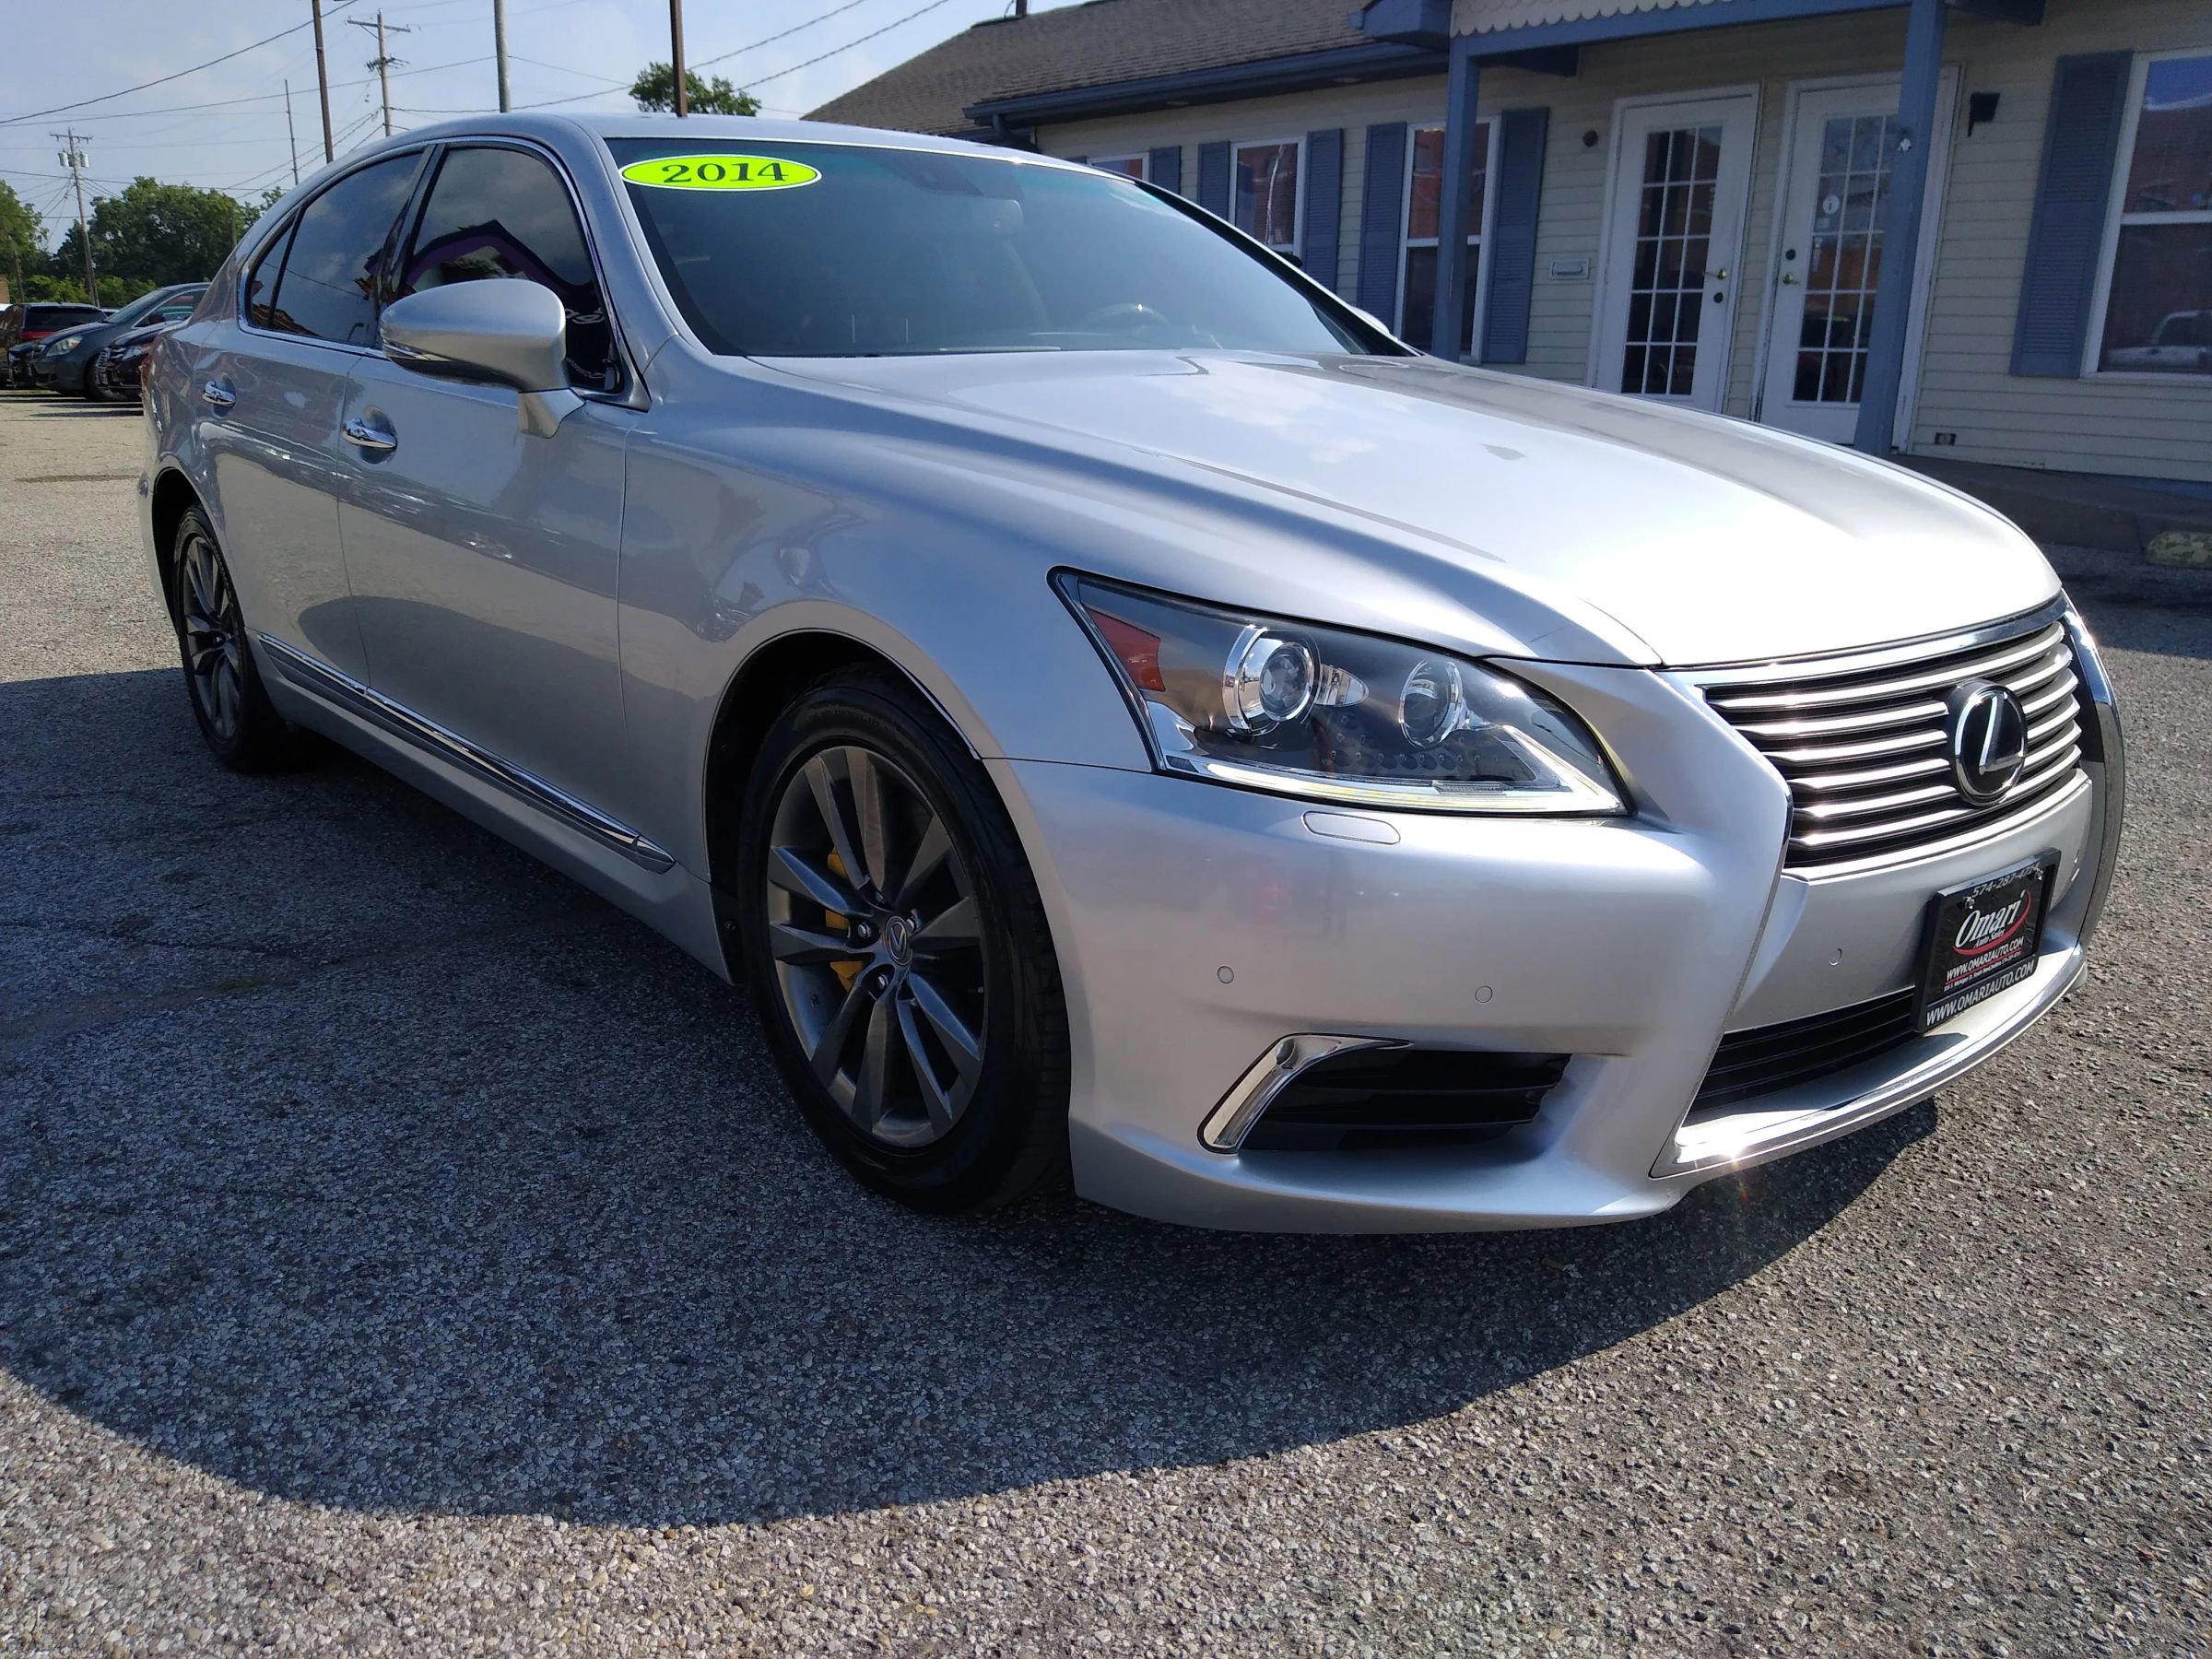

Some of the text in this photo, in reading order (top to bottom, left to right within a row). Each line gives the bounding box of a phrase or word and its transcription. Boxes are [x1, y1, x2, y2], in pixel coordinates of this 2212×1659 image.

[661, 162, 789, 182] 2014
[1955, 888, 2027, 948] Omari
[1946, 935, 2025, 982] WWW.OMARIAUTO.COM
[1925, 959, 2035, 1027] WWW.OMARIAUTO.COM
